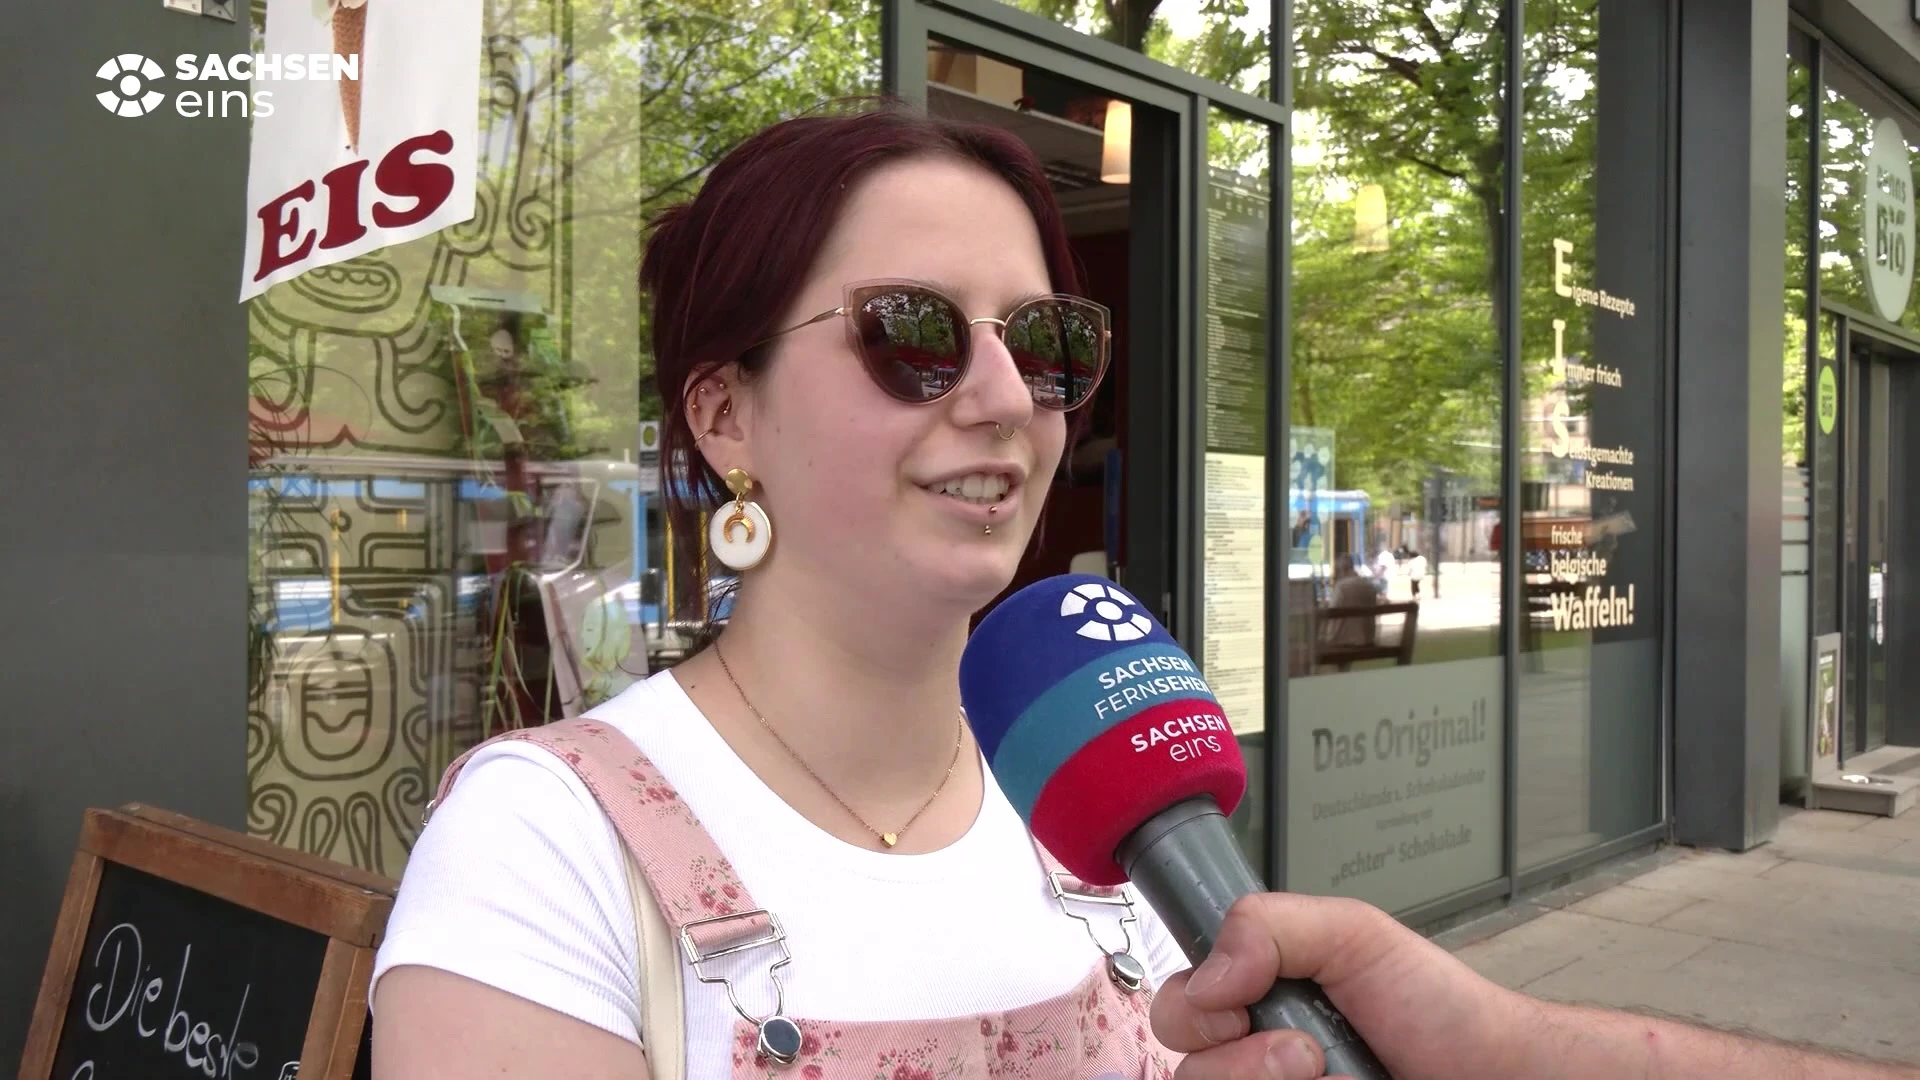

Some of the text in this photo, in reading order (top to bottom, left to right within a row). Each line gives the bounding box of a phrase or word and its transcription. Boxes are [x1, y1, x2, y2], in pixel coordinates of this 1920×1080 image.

[253, 129, 455, 283] EIS
[1599, 290, 1635, 319] Rezepte
[1596, 364, 1622, 388] frisch
[1585, 470, 1634, 492] Kreationen
[1551, 525, 1583, 545] frische
[1551, 551, 1607, 577] belgische
[1551, 583, 1635, 632] Waffeln!
[1098, 655, 1193, 690] SACHSEN
[1094, 677, 1210, 720] FERNSEHEN
[1130, 714, 1227, 753] SACHSEN
[1169, 734, 1222, 763] eins
[1312, 698, 1486, 772] Das Original!
[1398, 823, 1472, 863] Schokolade
[84, 922, 163, 1038] Die
